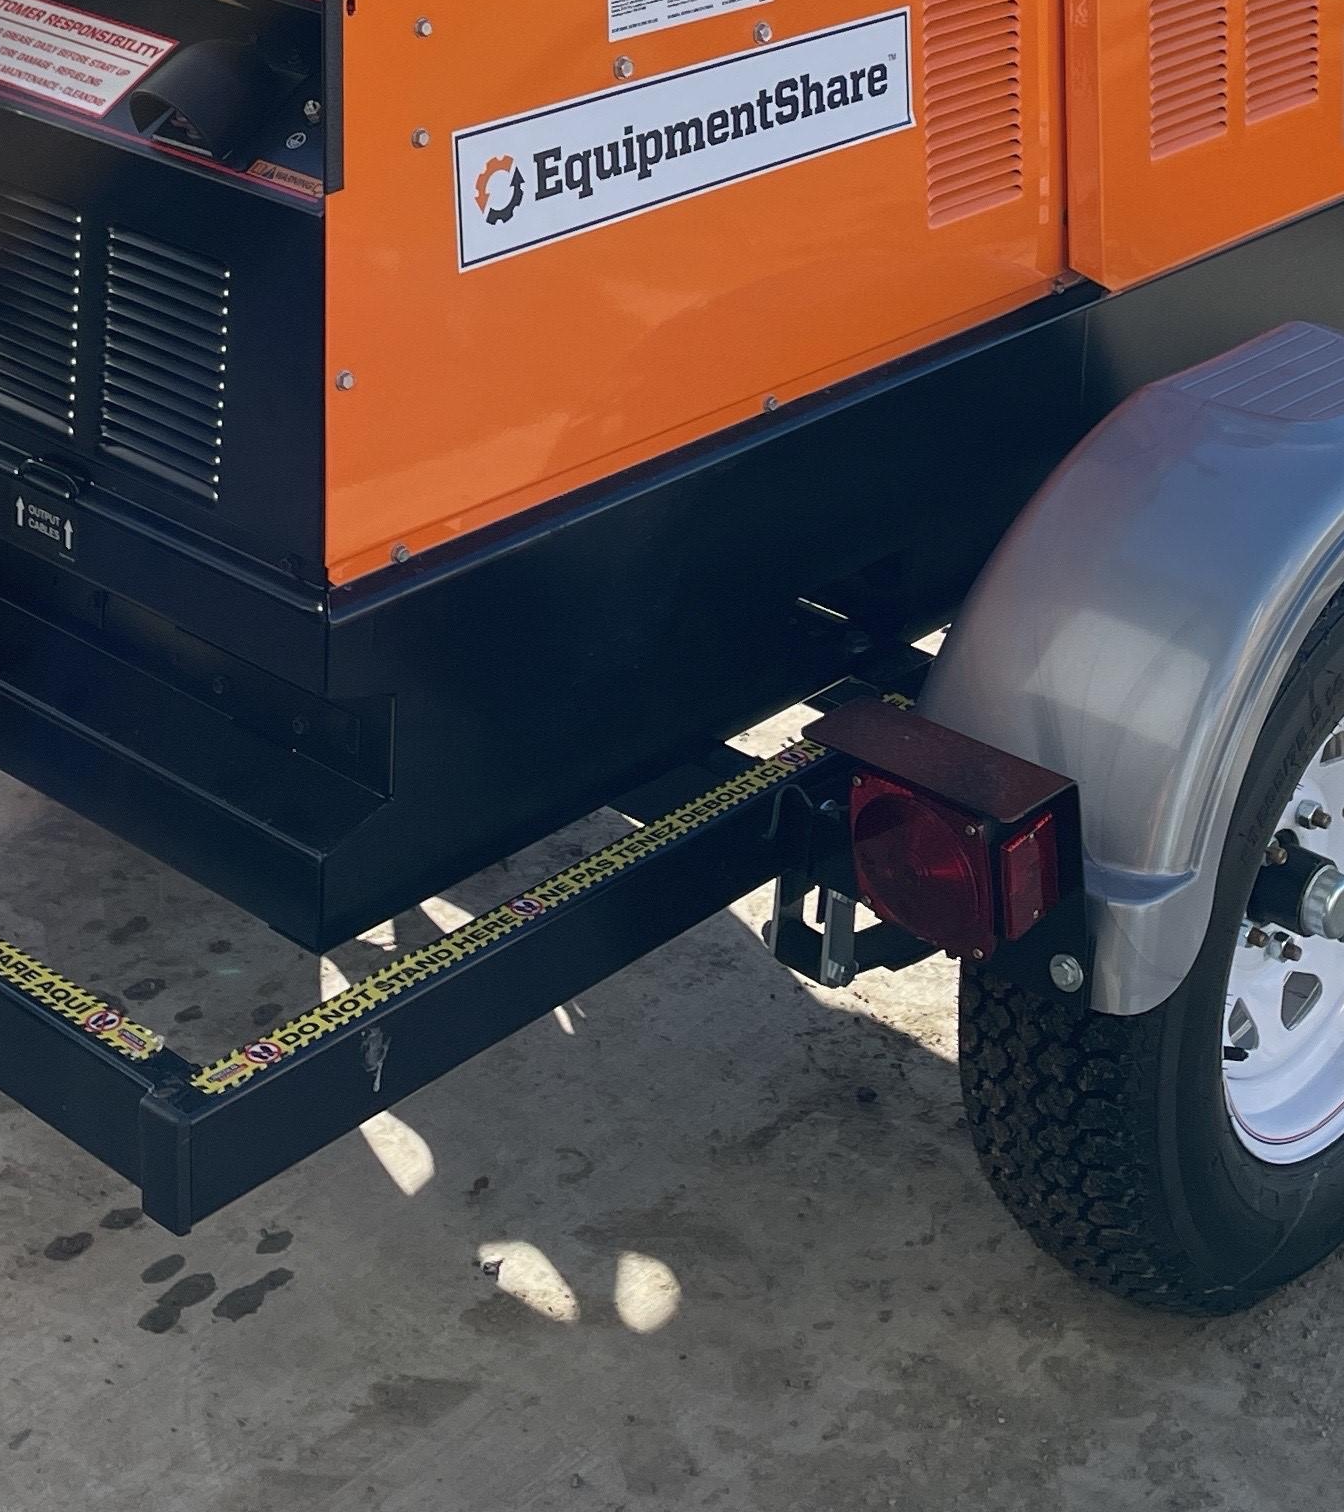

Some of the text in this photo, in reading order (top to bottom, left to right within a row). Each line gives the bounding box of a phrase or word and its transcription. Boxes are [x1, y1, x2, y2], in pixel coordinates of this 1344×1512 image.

[41, 13, 165, 59] RESPONSIBILITY
[86, 58, 119, 73] START
[113, 67, 132, 77] UP
[532, 60, 889, 202] EquipmentShare
[538, 764, 787, 903] NE PAS TENEZ DEBOUT ICI
[278, 912, 517, 1046] DO NOT STAND HERE
